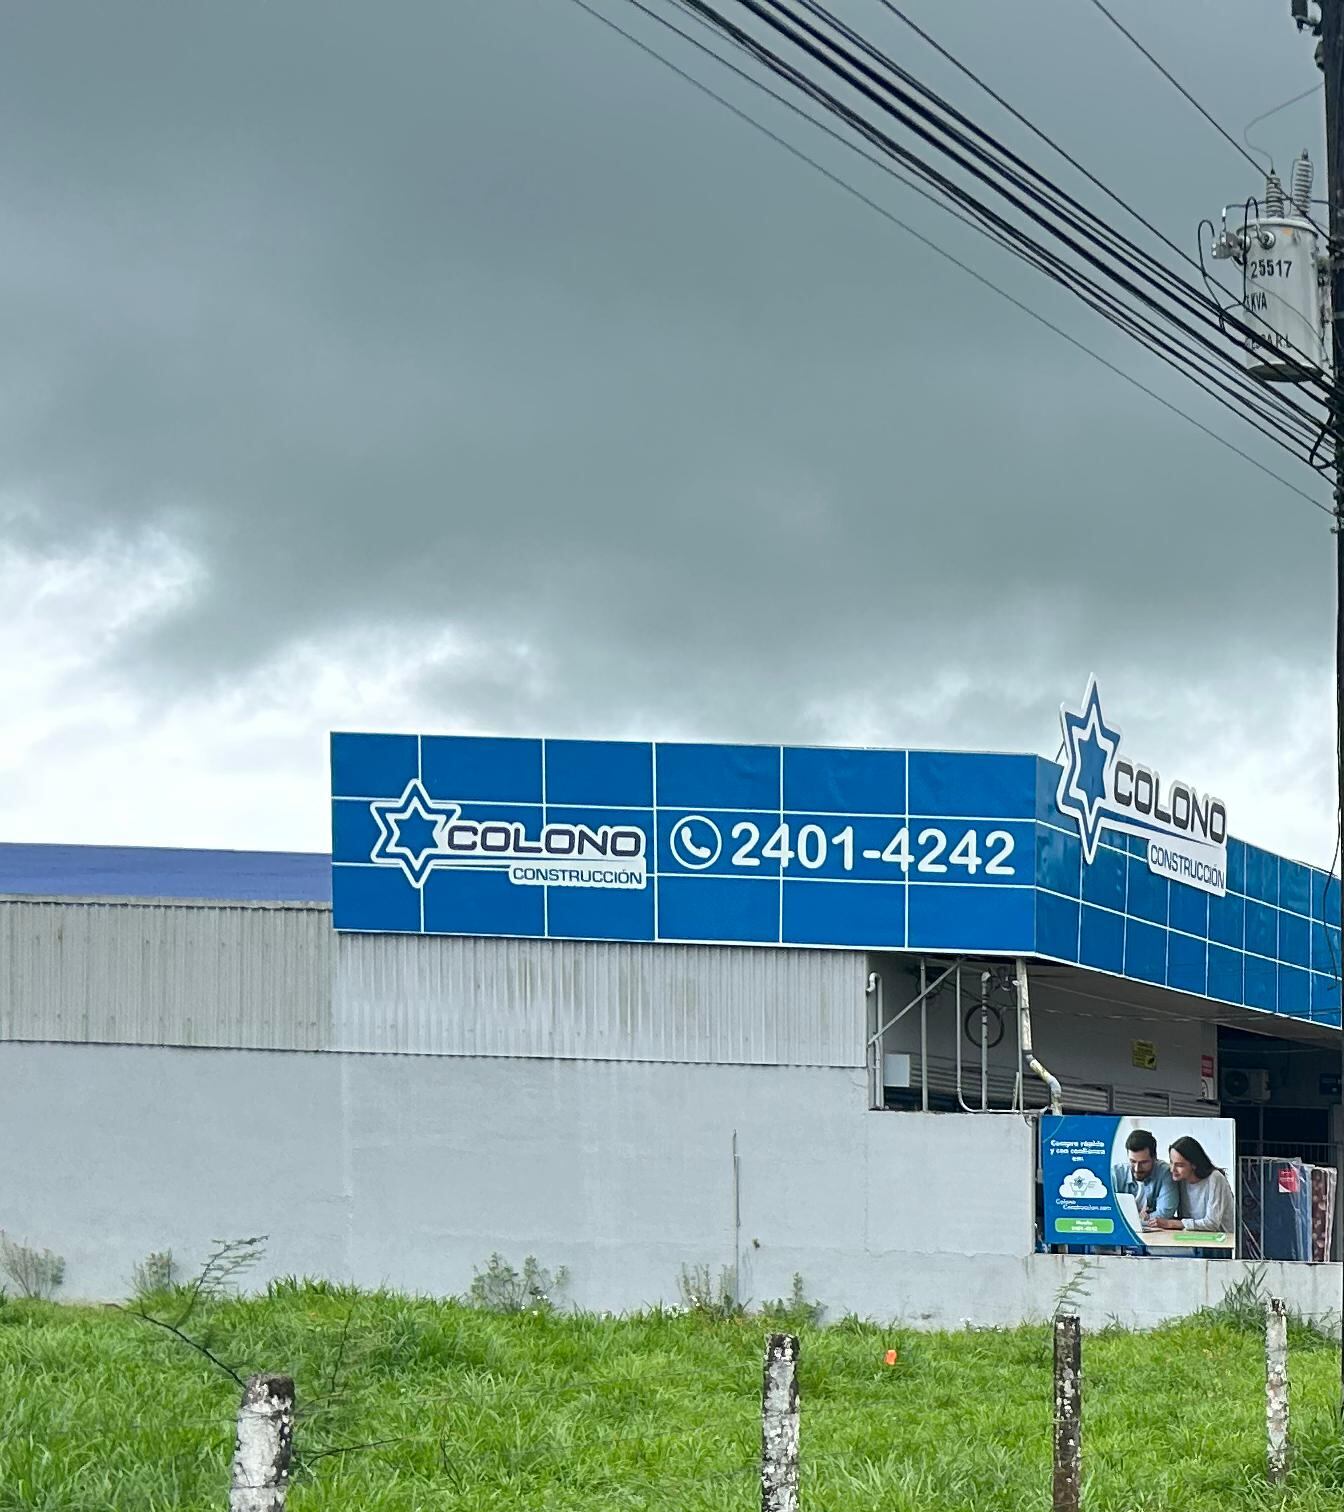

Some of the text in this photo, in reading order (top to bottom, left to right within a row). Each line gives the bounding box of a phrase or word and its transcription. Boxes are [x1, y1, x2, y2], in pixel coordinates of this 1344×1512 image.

[1250, 259, 1292, 279] 25517
[1114, 760, 1227, 844] COLONO
[446, 823, 643, 858] COLONO
[731, 820, 1015, 876] 2401-4242
[512, 867, 643, 886] CONSTRUCCIÓN
[1150, 844, 1225, 889] CONSTRUCCIÓN
